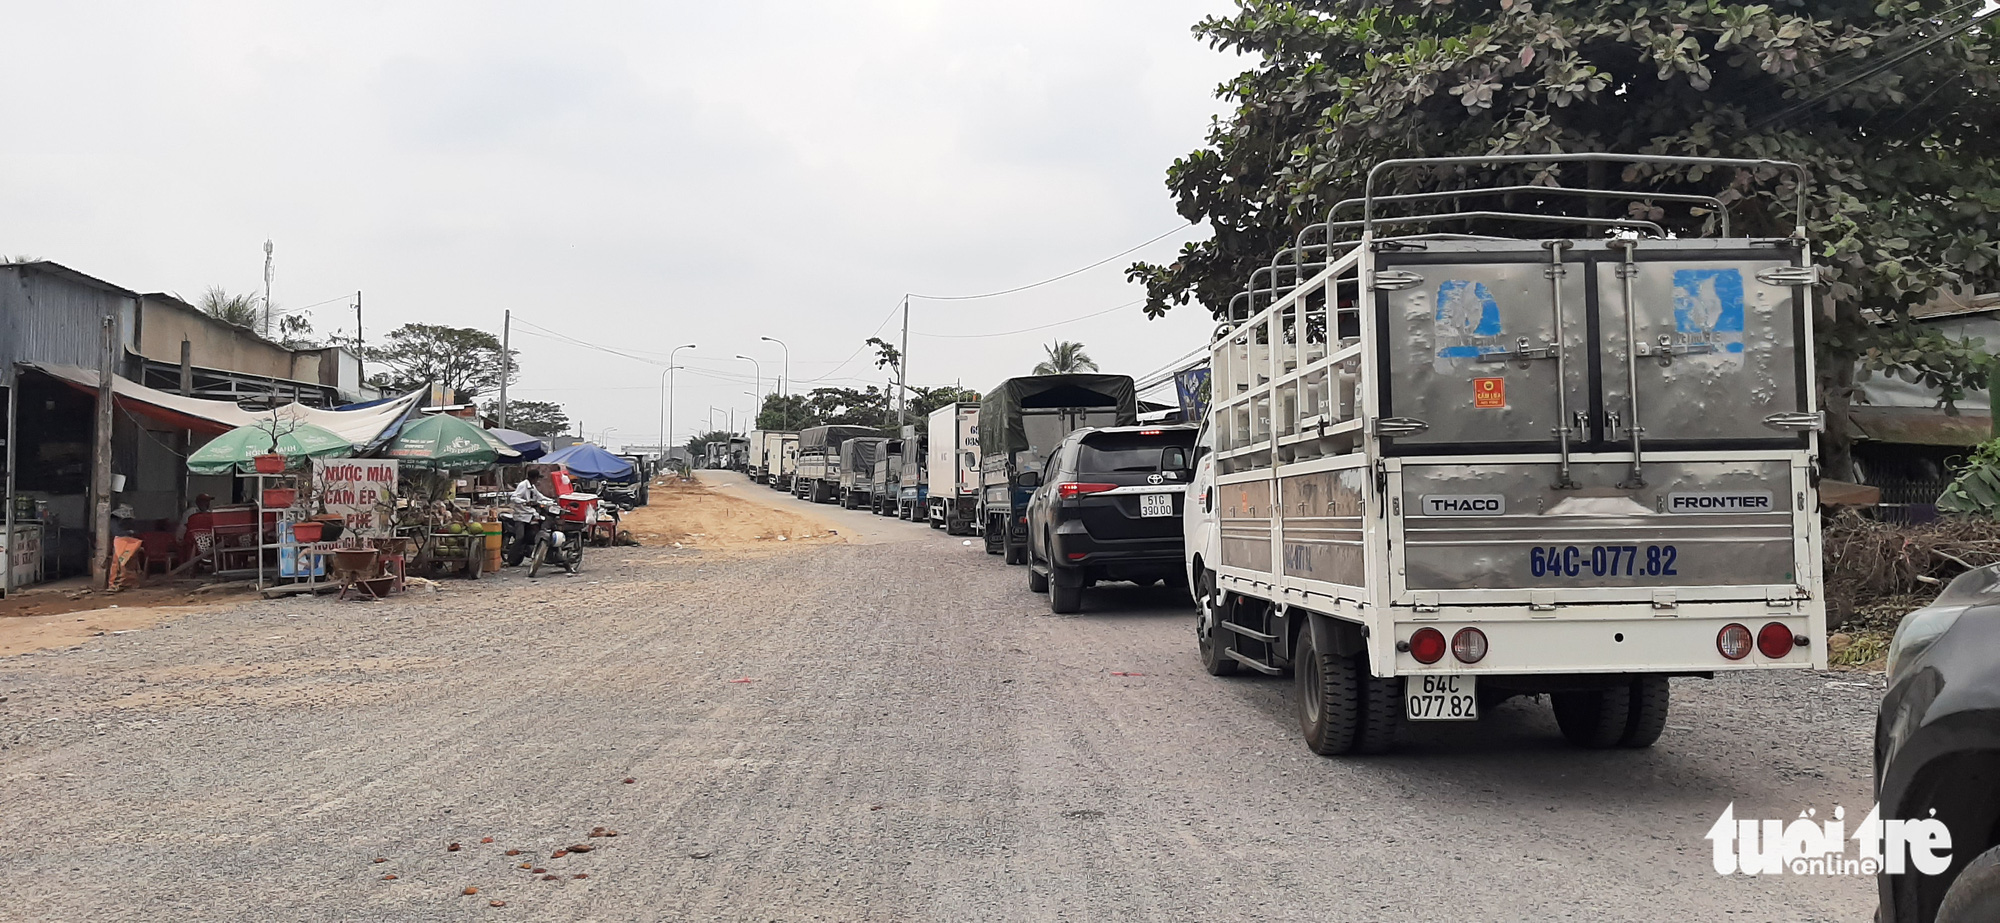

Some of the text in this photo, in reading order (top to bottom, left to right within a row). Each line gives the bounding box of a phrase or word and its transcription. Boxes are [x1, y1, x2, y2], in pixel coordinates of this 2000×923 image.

[324, 463, 363, 482] NƯỚC
[366, 463, 393, 482] MÍA
[359, 485, 377, 505] ÉP
[1673, 496, 1768, 509] FRONTIER
[1430, 499, 1499, 511] THACO
[1530, 545, 1678, 577] 64C-077.82
[1423, 675, 1460, 693] 64C
[1410, 695, 1475, 718] 077.82
